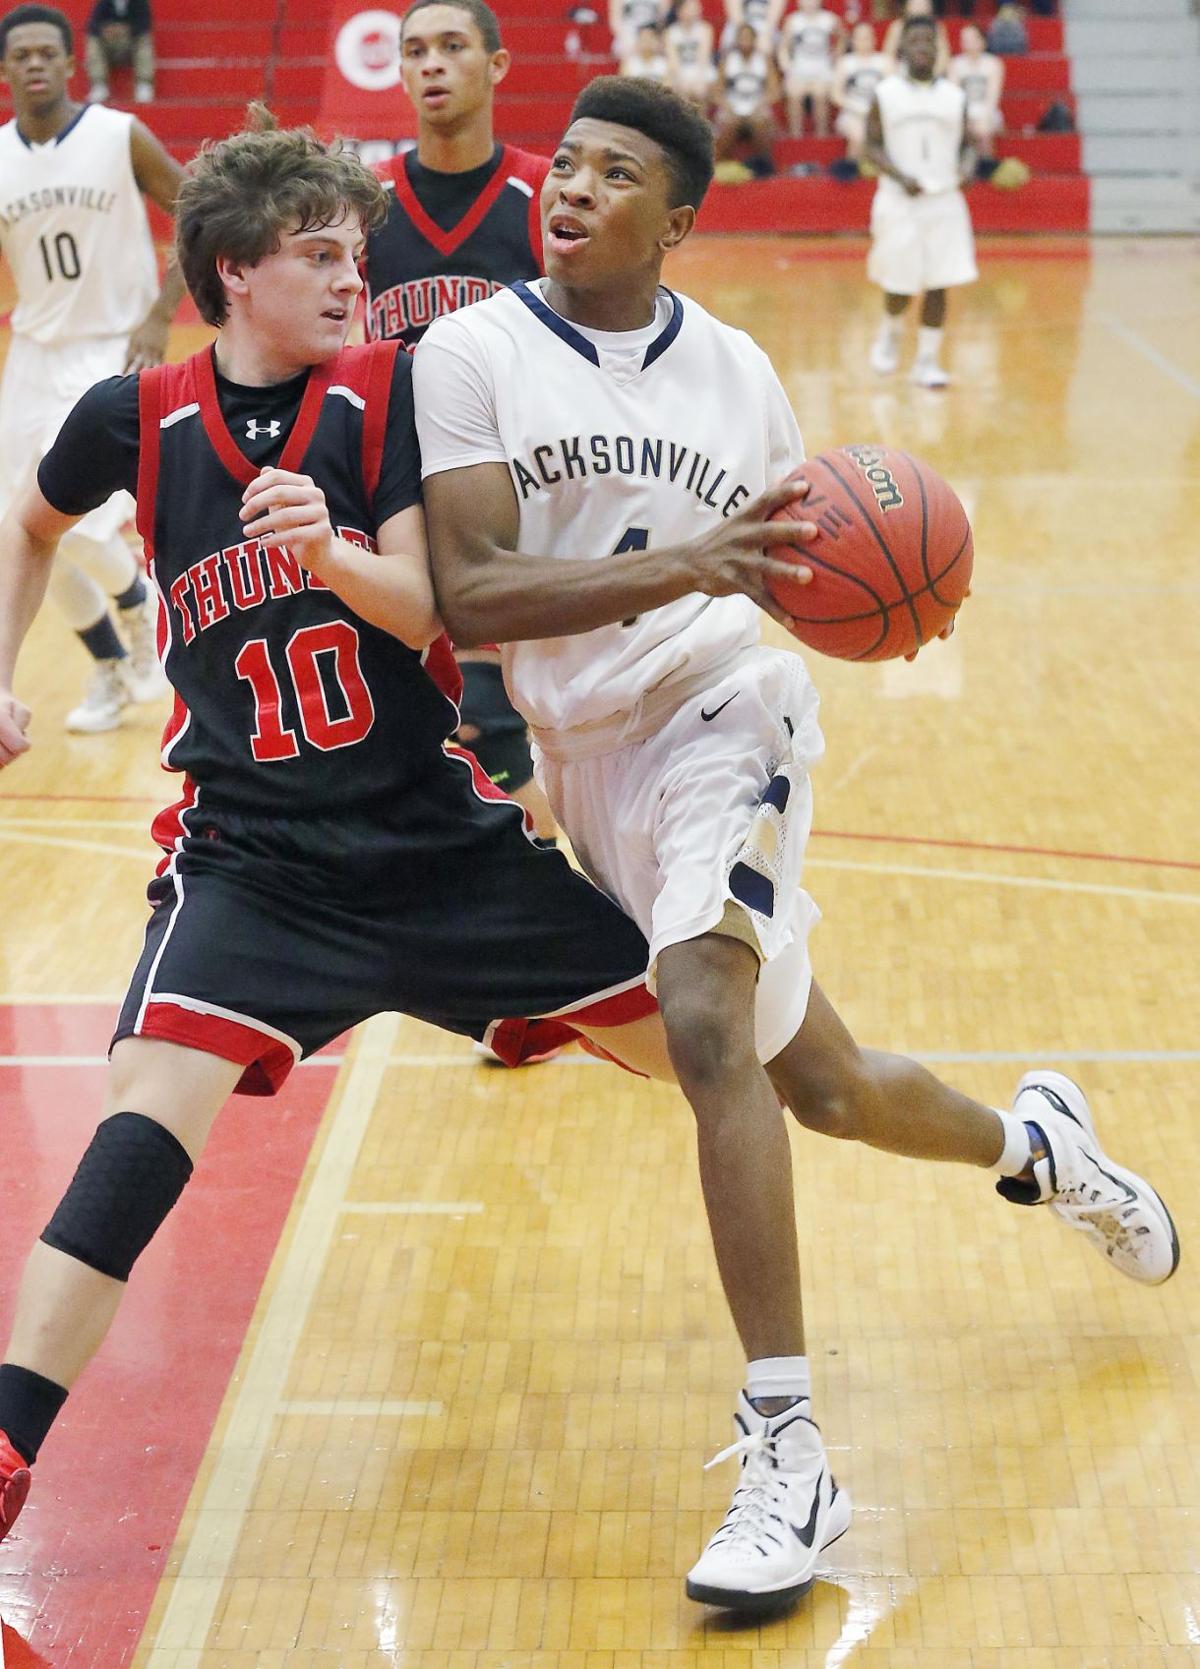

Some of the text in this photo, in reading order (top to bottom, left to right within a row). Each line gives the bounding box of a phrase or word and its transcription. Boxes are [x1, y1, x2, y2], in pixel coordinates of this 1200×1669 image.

[40, 231, 81, 283] 10
[370, 275, 506, 339] THUND
[235, 619, 375, 762] 10
